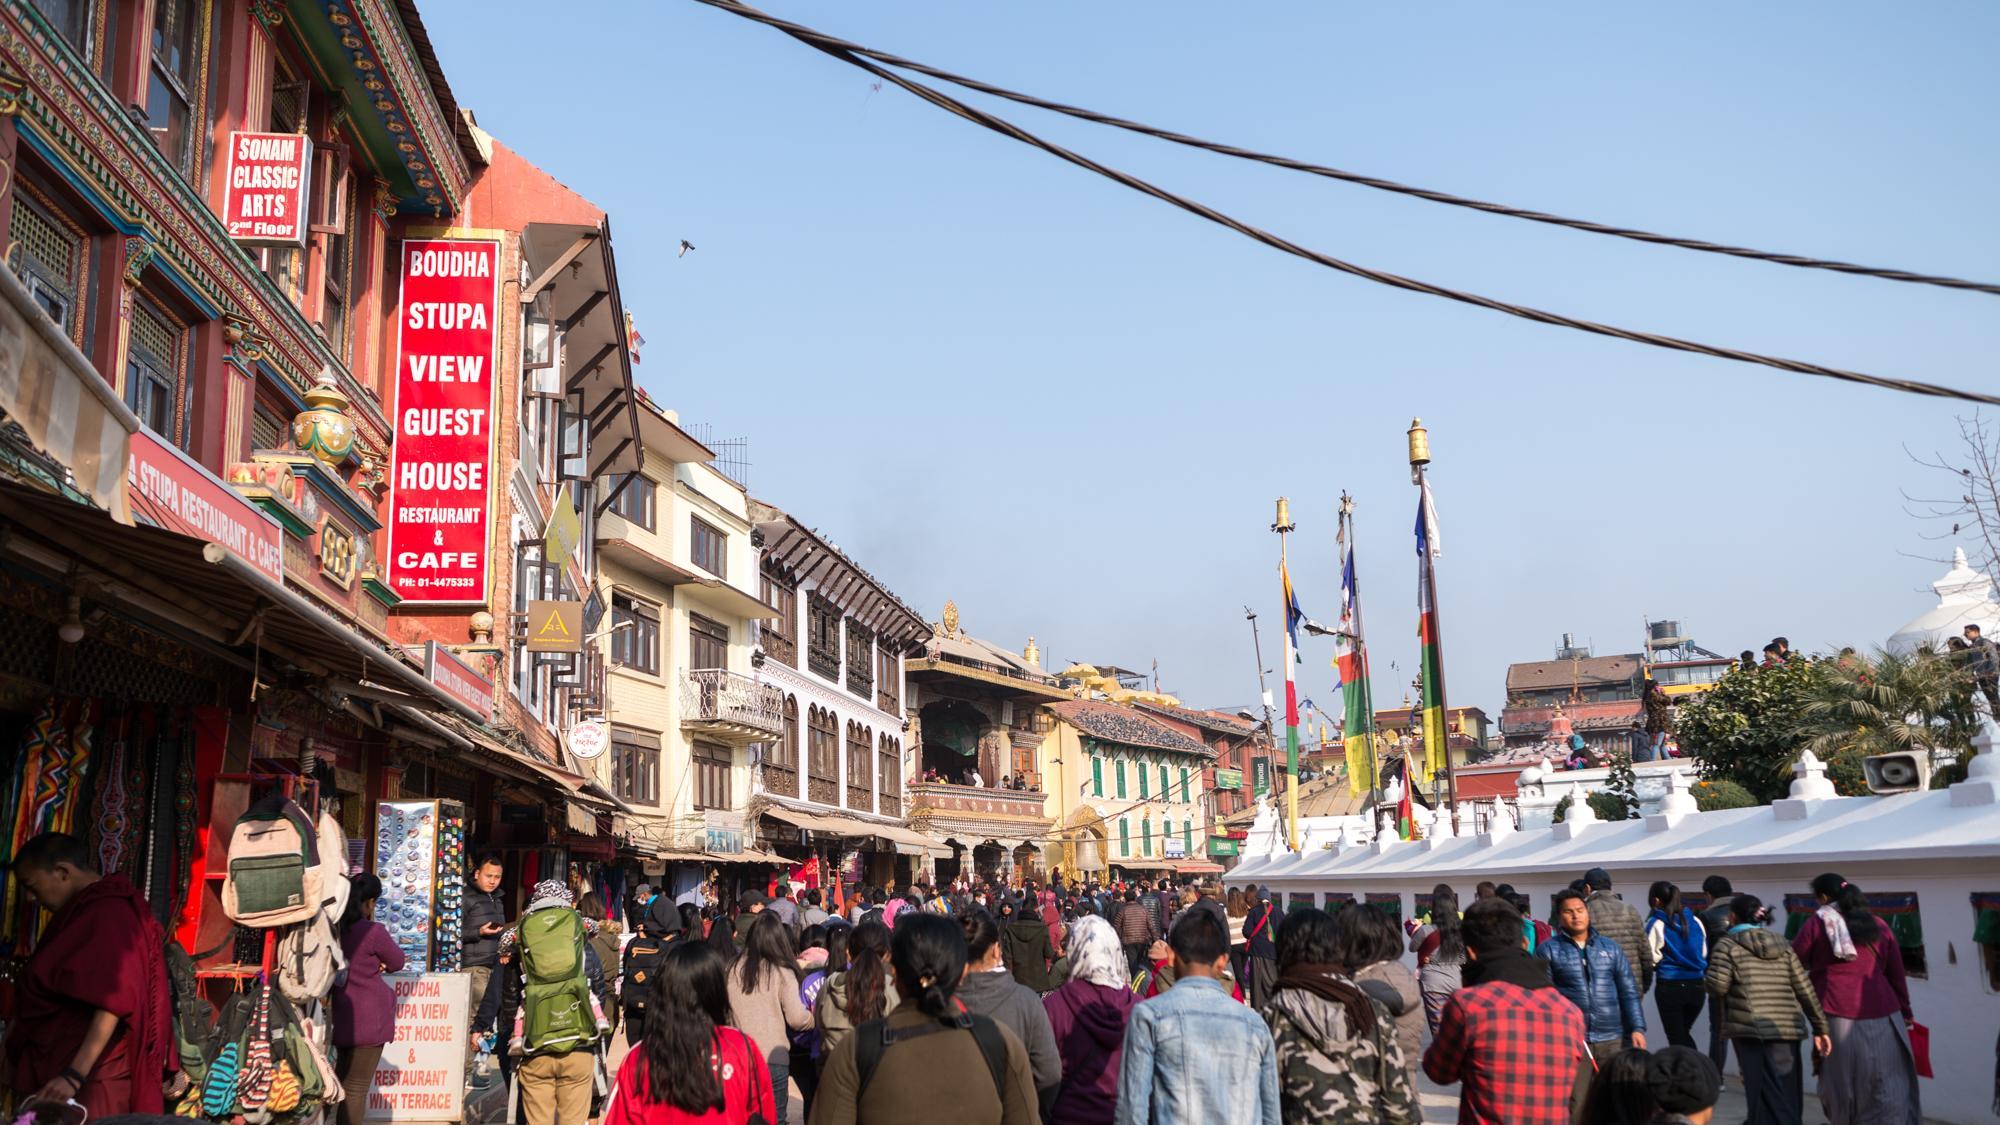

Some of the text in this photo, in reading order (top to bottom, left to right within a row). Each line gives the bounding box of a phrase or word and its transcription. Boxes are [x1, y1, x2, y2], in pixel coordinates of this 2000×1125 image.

[239, 138, 295, 161] SONAM
[233, 165, 298, 189] CLASSIC
[241, 194, 286, 217] ARTS
[229, 221, 293, 235] 2nd Floor
[410, 250, 489, 277] BOUDHA
[408, 302, 487, 329] STUPA
[409, 355, 484, 382] VIEW
[404, 408, 484, 436] GUEST
[400, 462, 482, 490] HOUSE
[140, 460, 179, 515] STUPA
[181, 487, 247, 556] RESTAURANT
[250, 532, 256, 560] &
[258, 538, 280, 575] CAFE
[399, 507, 480, 523] RESTAURANT
[433, 530, 443, 545] &
[397, 552, 477, 568] CAFE
[399, 577, 474, 587] PH: 01-4475333
[395, 981, 440, 997] BOUDHA
[396, 1003, 449, 1019] UPA VIEW
[394, 1026, 452, 1041] EST HOUSE
[408, 1048, 416, 1063] &
[374, 1070, 448, 1086] RESTAURANT
[369, 1093, 451, 1109] WITH TERRACE
